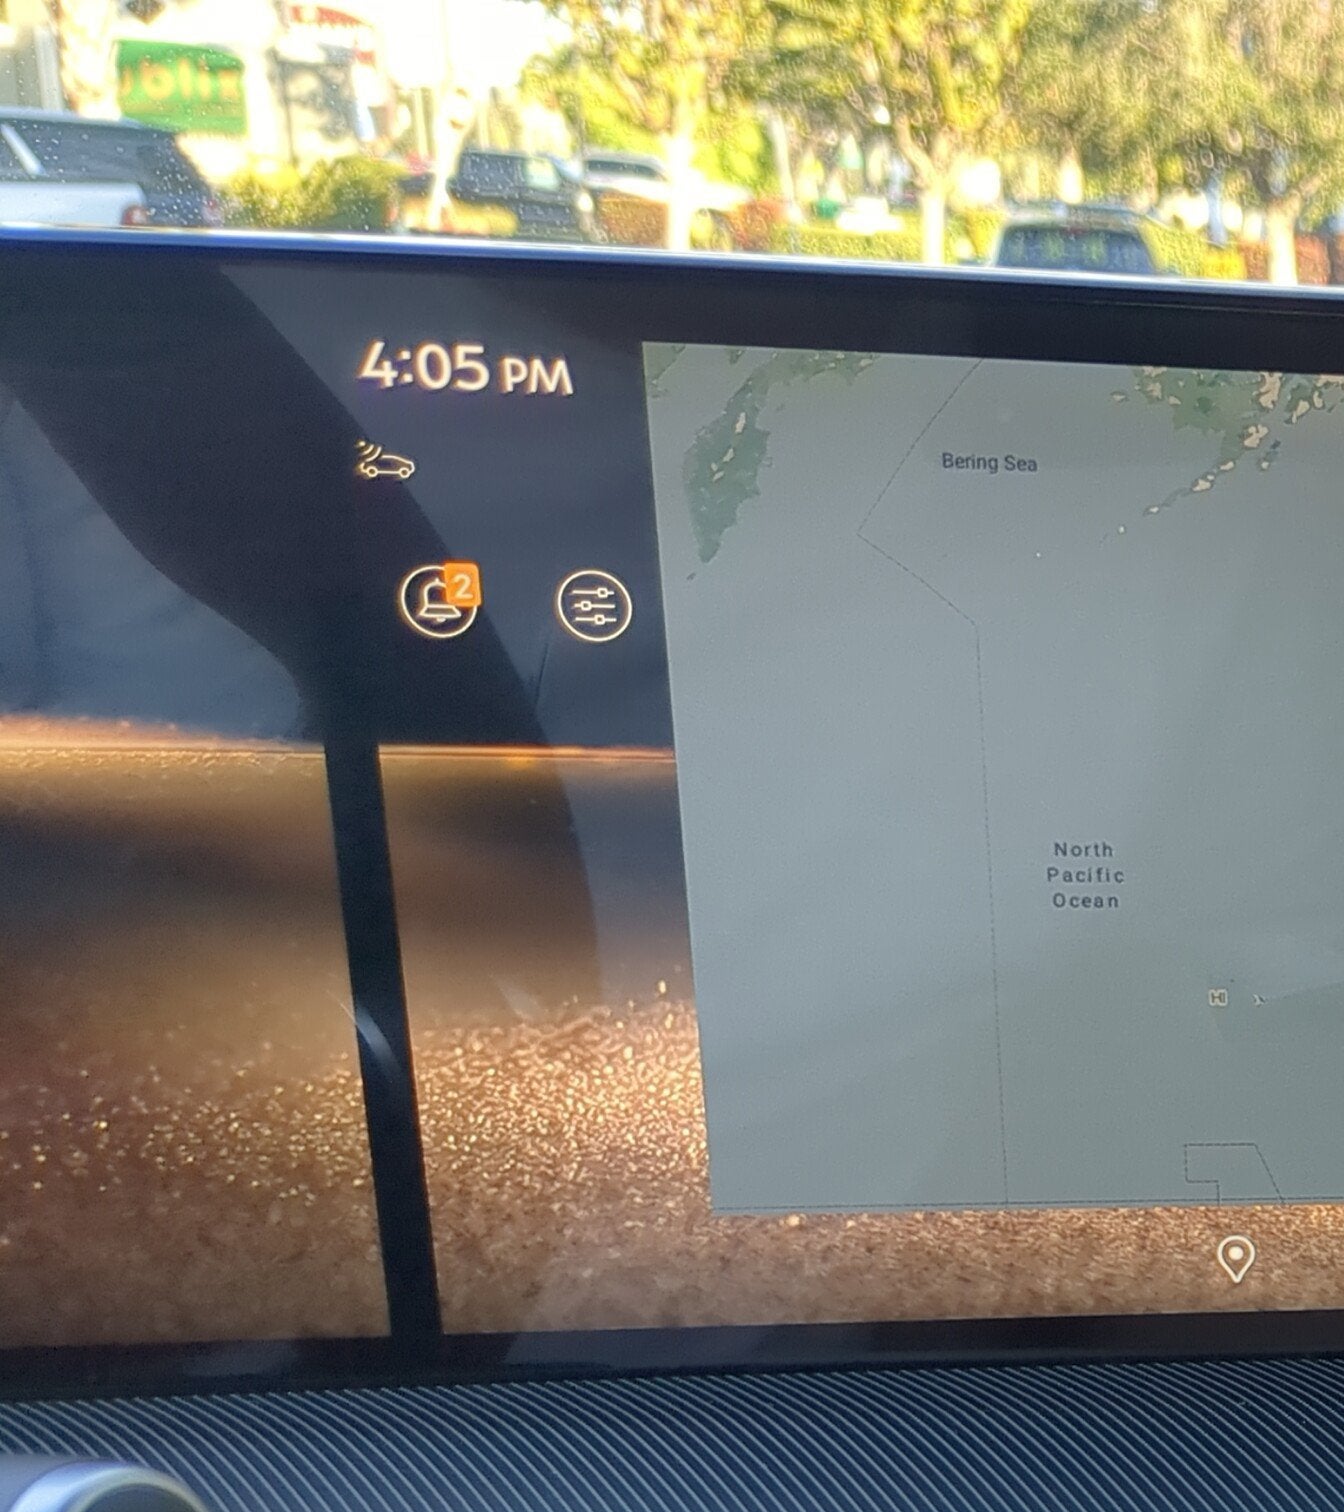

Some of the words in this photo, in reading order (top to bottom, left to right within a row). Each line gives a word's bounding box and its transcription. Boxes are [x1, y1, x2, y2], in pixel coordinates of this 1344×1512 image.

[357, 340, 490, 392] 4:05
[500, 356, 574, 396] PM
[941, 452, 999, 474] Bering
[1004, 454, 1038, 472] Sea
[452, 573, 474, 599] 2
[1054, 841, 1114, 858] North
[1046, 866, 1125, 884] Pacific
[1052, 892, 1119, 909] Ocean
